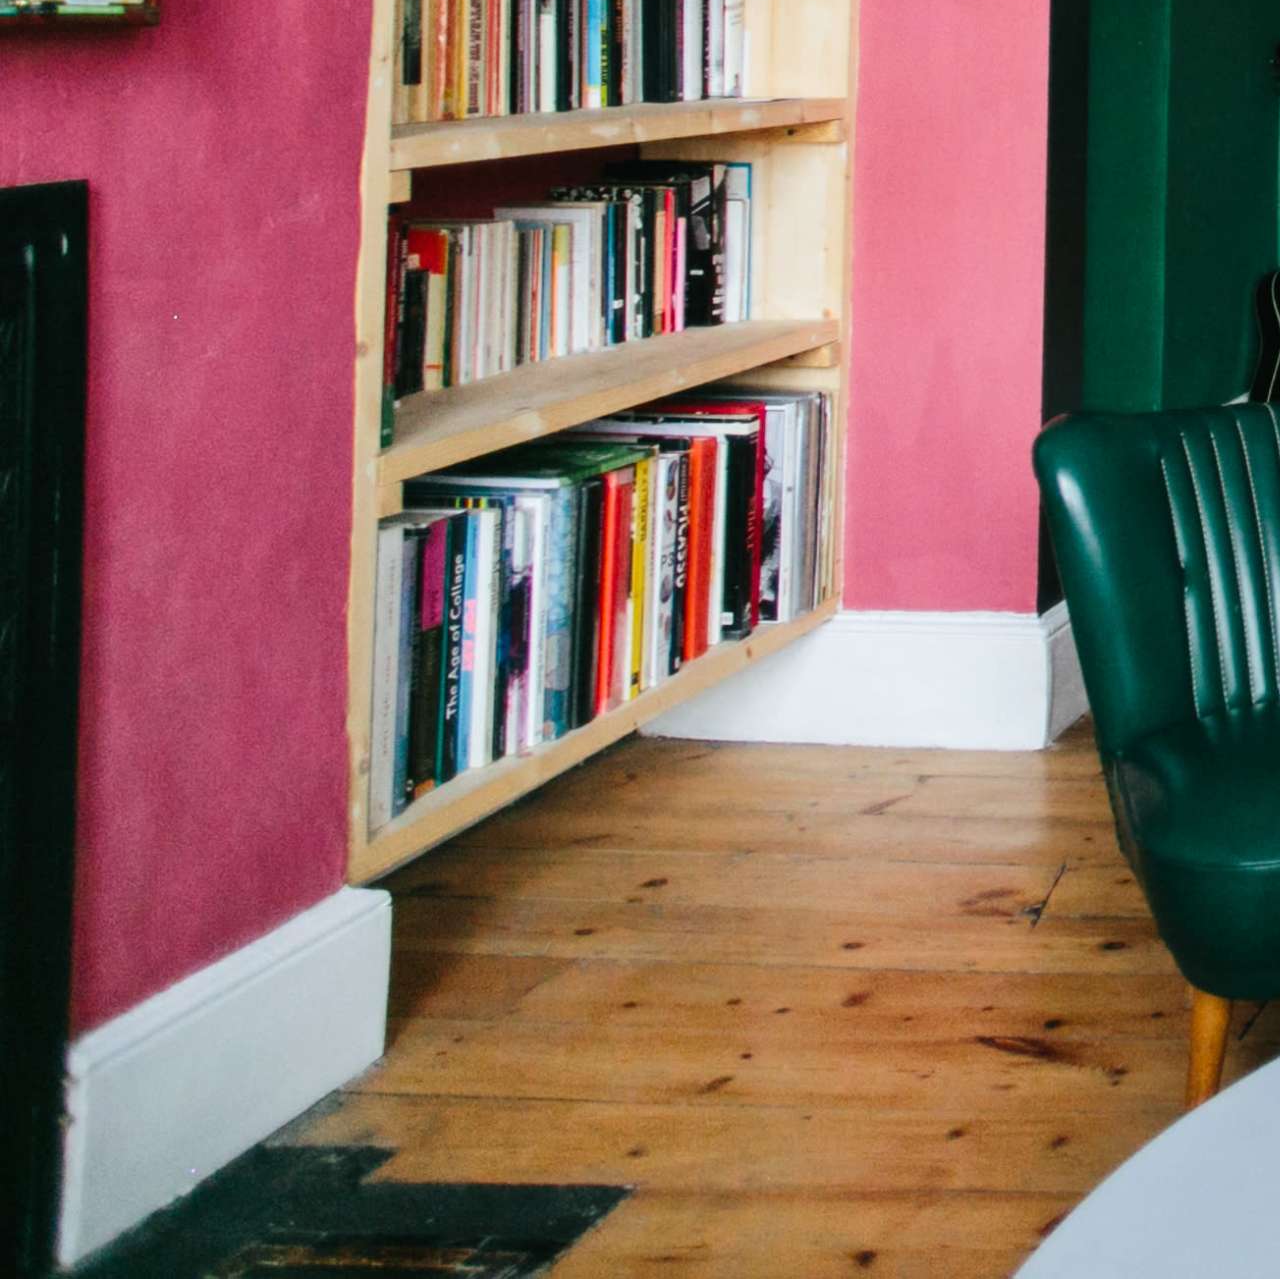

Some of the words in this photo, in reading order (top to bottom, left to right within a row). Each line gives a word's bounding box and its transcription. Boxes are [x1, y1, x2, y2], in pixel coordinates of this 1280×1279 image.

[676, 504, 688, 589] PICASSO
[450, 553, 465, 620] Collage
[449, 624, 461, 642] of
[447, 647, 461, 680] Age
[445, 685, 458, 721] The
